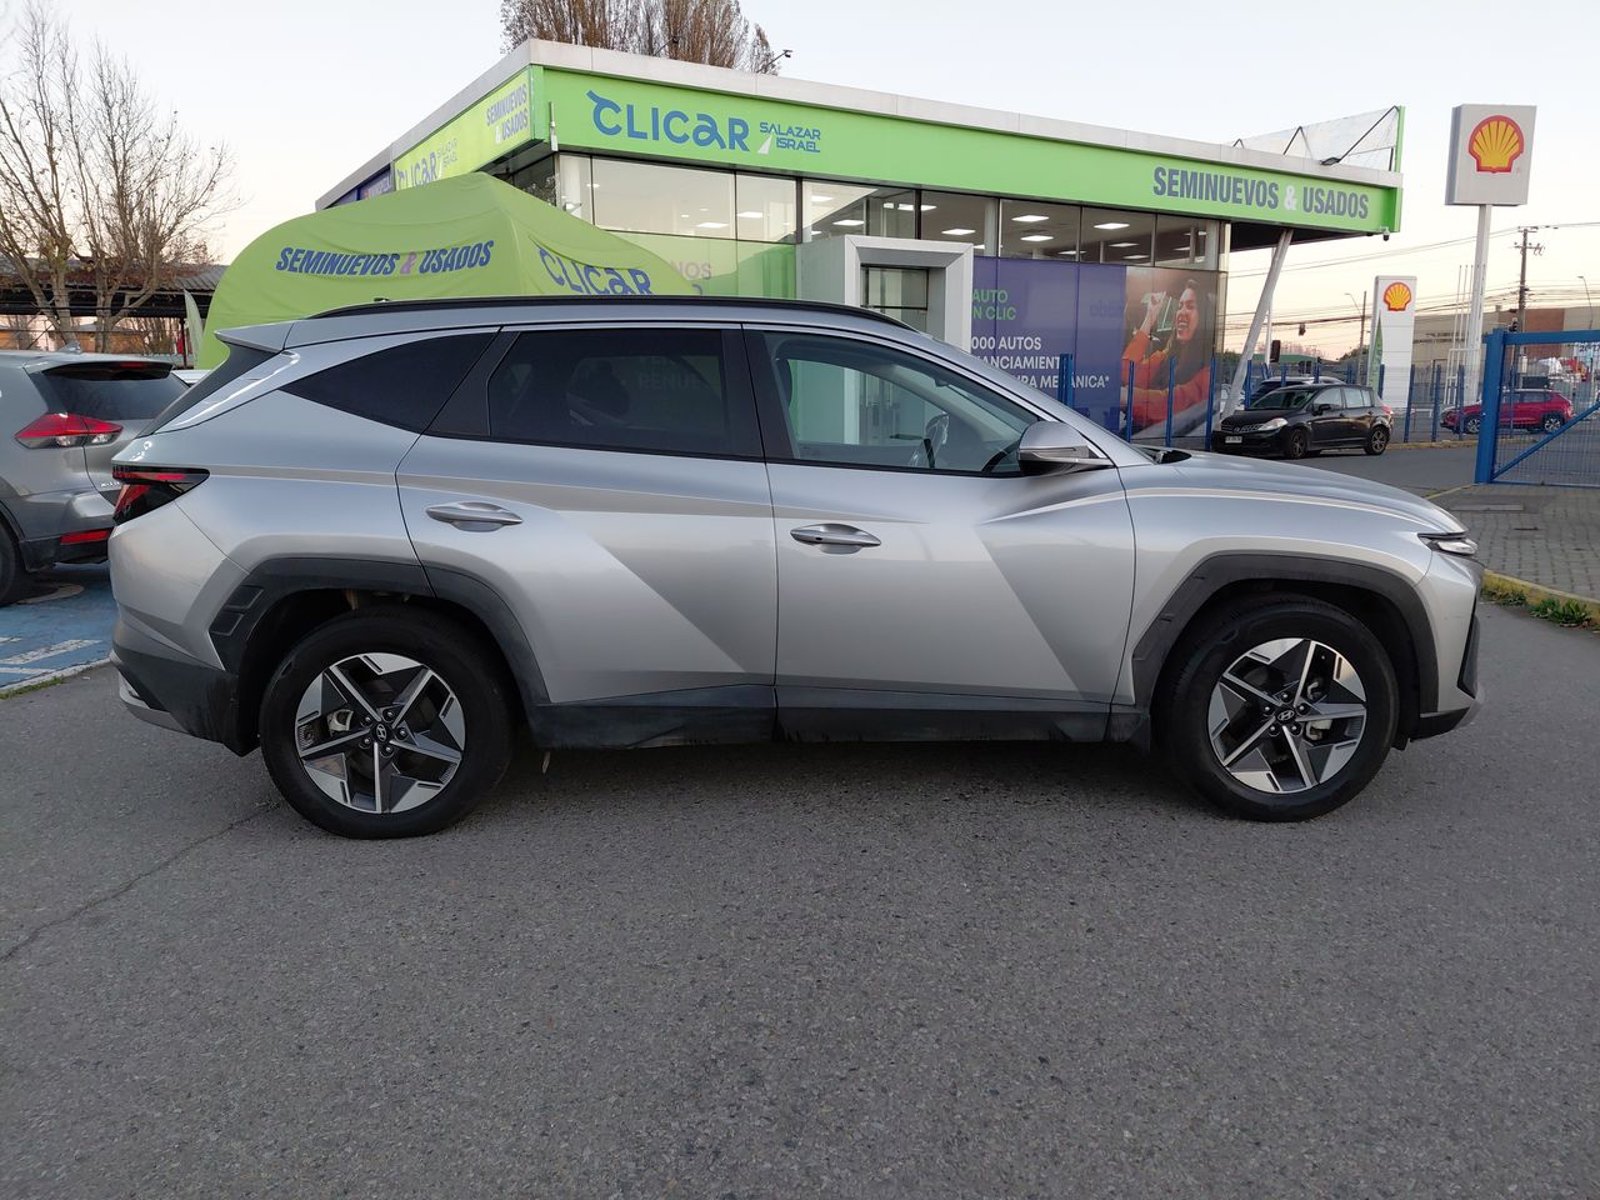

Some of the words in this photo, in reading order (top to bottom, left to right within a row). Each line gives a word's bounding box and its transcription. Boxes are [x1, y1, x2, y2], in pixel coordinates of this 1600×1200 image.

[502, 107, 528, 141] USADOS
[759, 121, 821, 140] SALAZAR
[776, 137, 821, 153] ISRAEL
[1153, 166, 1279, 210] SEMINUEVOS
[1284, 184, 1297, 211] &
[1302, 186, 1369, 219] USADOS
[276, 247, 400, 276] SEMINUEVOS
[400, 251, 417, 274] &
[419, 239, 494, 274] USADOS
[972, 289, 1008, 303] AUTO
[985, 306, 1017, 320] CLIC
[998, 336, 1042, 350] AUTOS
[978, 355, 1060, 370] ANCIAMIENT
